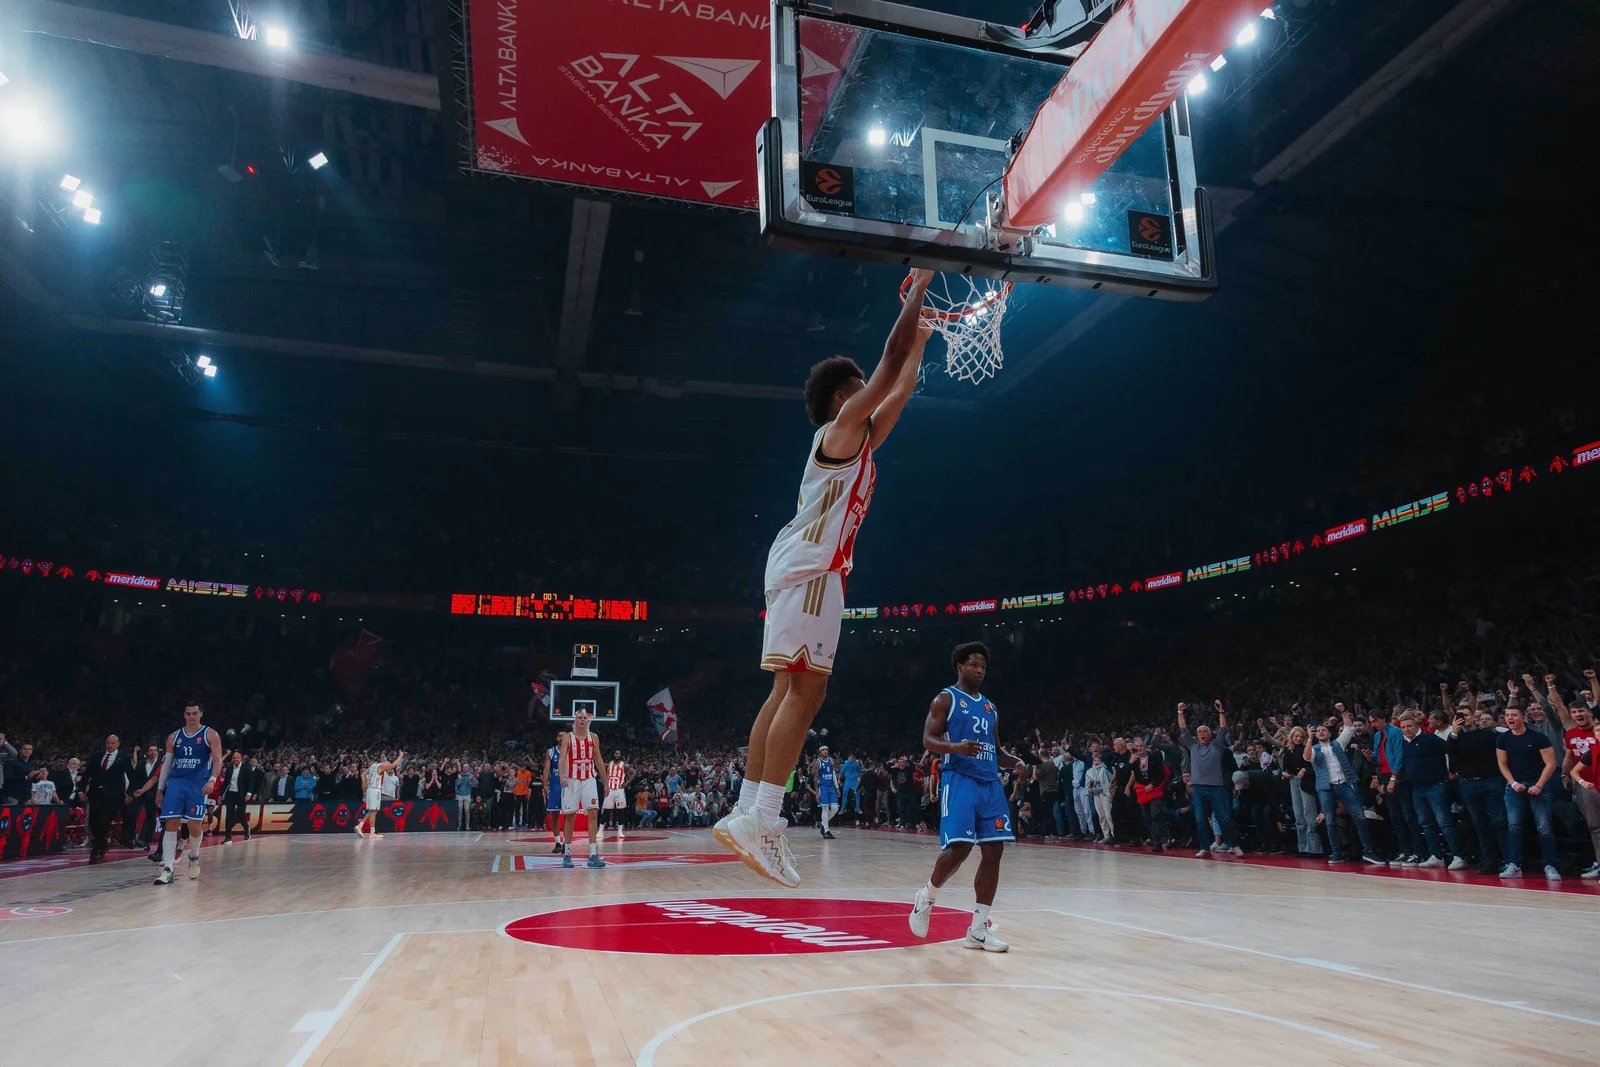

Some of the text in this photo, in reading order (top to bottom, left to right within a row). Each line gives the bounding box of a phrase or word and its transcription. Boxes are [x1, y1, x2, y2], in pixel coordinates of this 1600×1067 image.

[497, 0, 517, 111] ALTABANK
[570, 54, 672, 150] BANKA
[1095, 124, 1142, 164] abu
[1132, 51, 1211, 121] dhabi
[1075, 106, 1132, 164] experience
[532, 154, 690, 187] ALTABANKA
[806, 194, 853, 207] EuroLeague
[1131, 240, 1171, 253] EuroLeague
[1327, 523, 1365, 542] meridian
[108, 574, 158, 588] meridian
[1147, 575, 1180, 589] meridian
[961, 601, 995, 612] meridian
[972, 715, 989, 735] 24
[183, 746, 193, 756] 11
[645, 901, 893, 947] meridian
